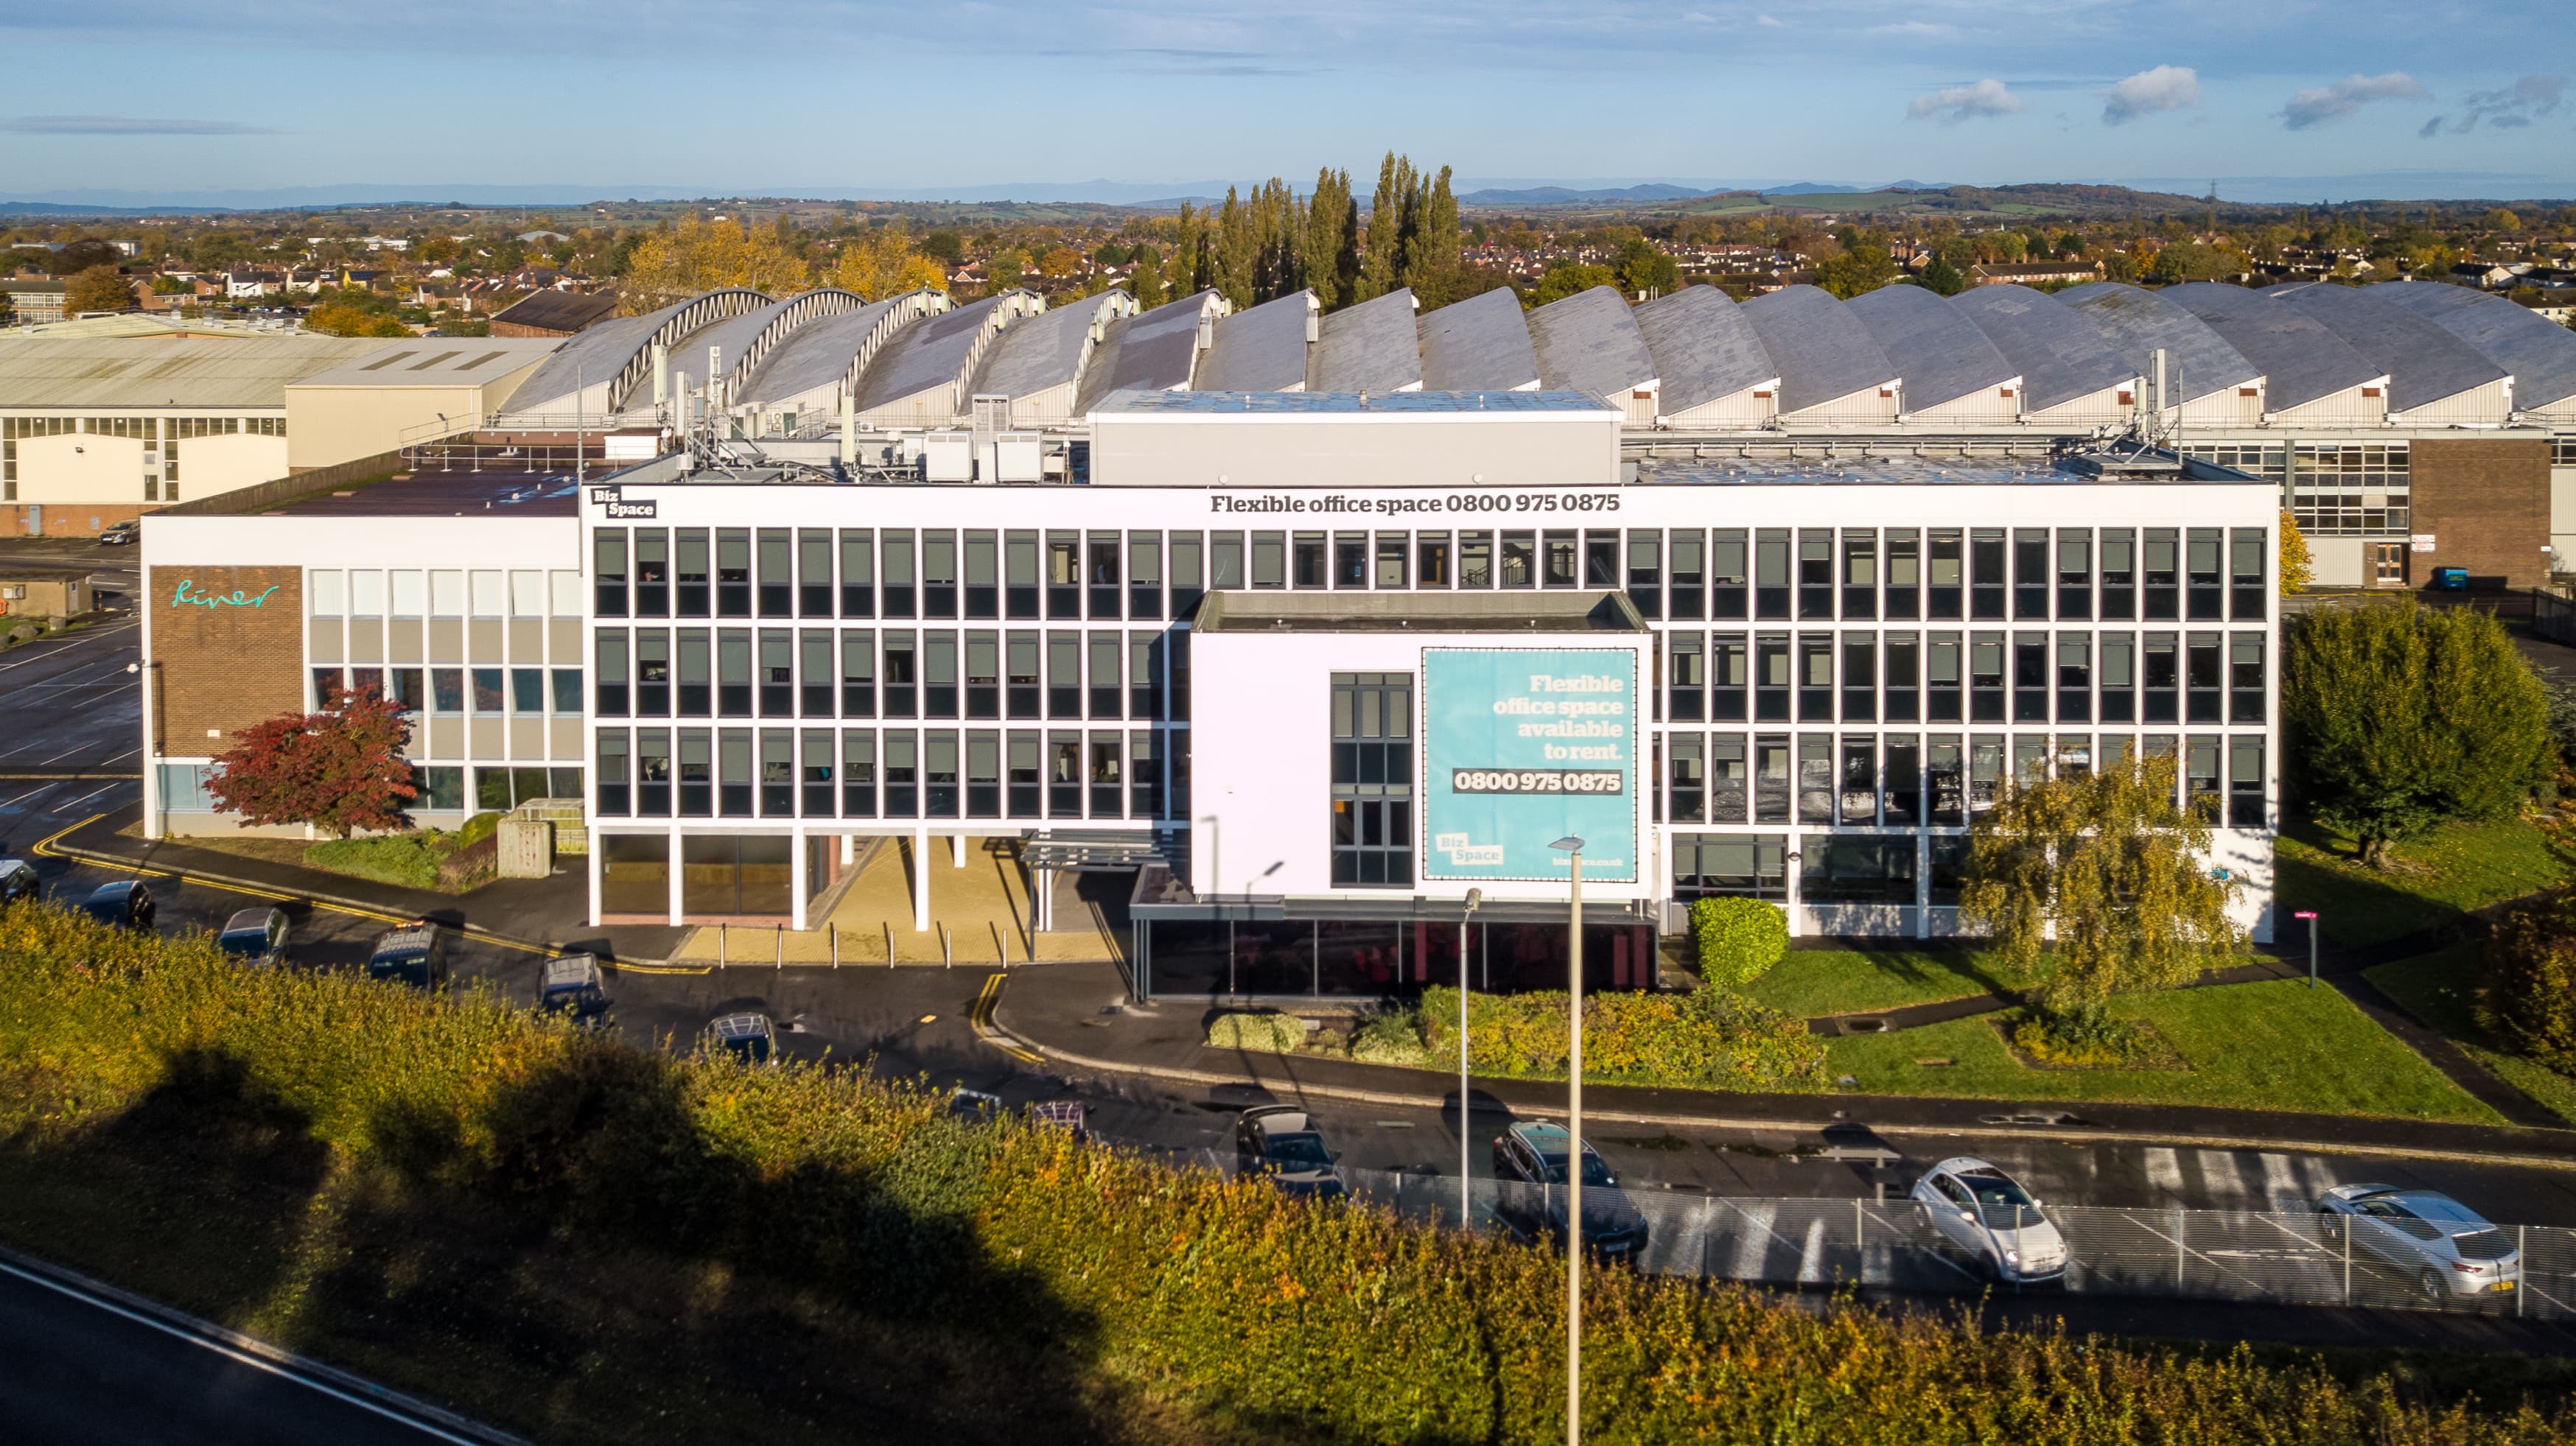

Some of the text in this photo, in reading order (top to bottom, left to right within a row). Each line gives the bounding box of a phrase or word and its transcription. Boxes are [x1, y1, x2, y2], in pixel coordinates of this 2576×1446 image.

[594, 490, 619, 502] Biz
[609, 502, 654, 517] Space
[1211, 494, 1620, 516] Flexible office space 0800 975 0875
[1530, 674, 1624, 692] Flexible
[1493, 696, 1624, 718] office space
[1517, 719, 1624, 737] available
[1544, 743, 1623, 759] to rent.
[1455, 772, 1621, 791] 0800 975 0875
[1441, 837, 1464, 848] Biz
[1455, 849, 1499, 862] Space
